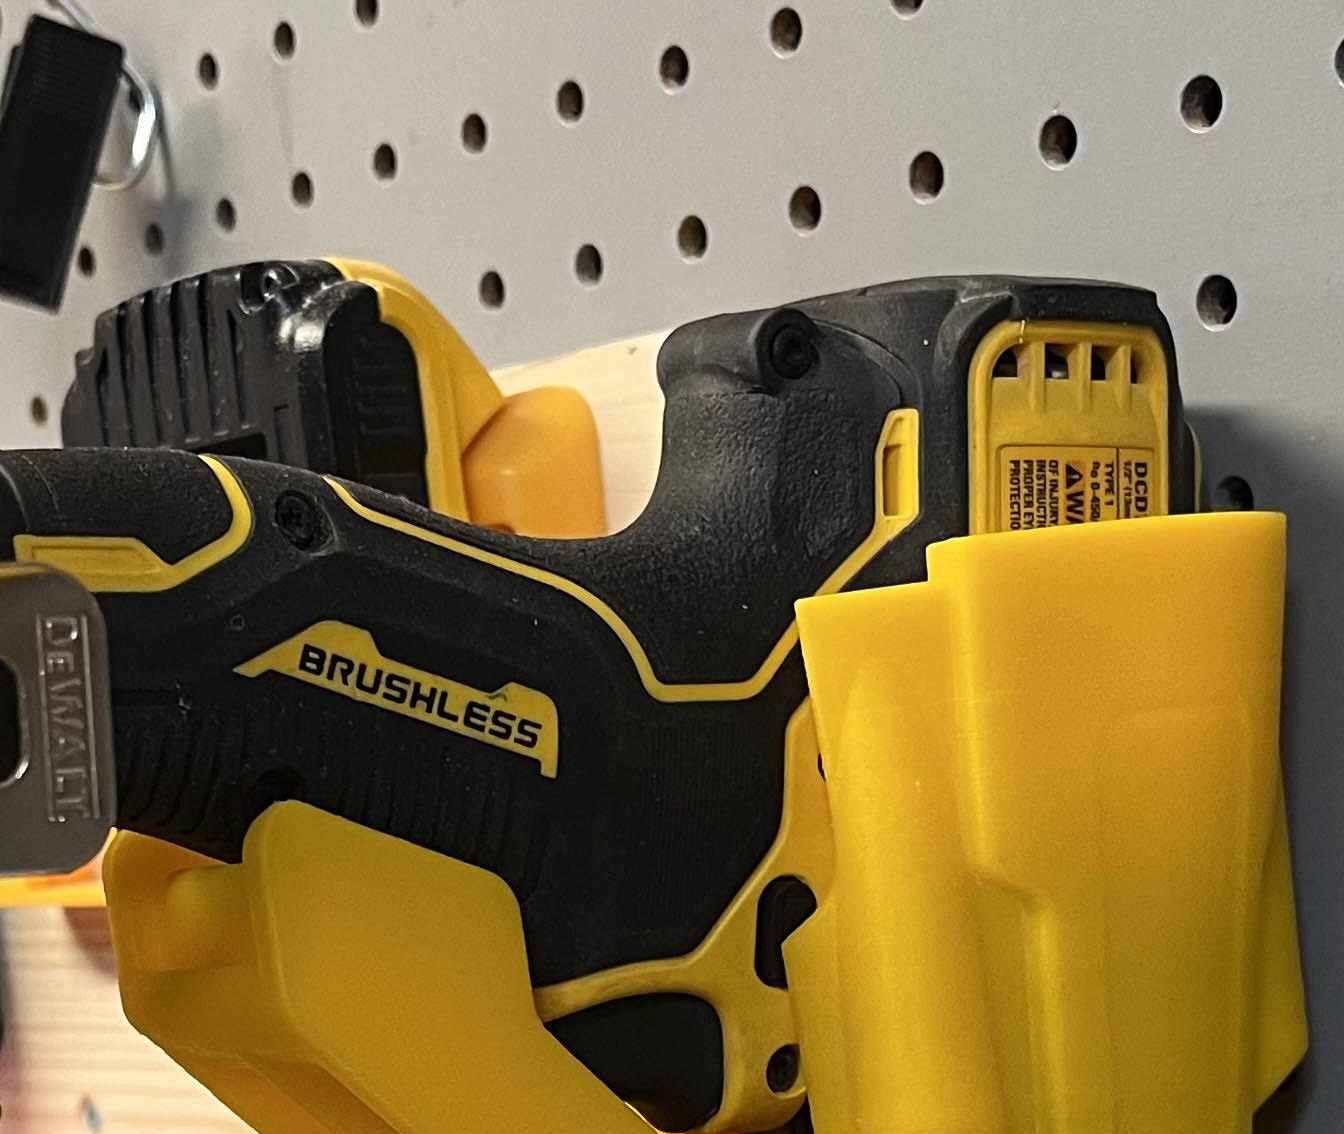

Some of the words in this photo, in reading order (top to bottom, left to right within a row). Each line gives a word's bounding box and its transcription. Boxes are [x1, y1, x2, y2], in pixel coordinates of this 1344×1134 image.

[1023, 459, 1034, 508] PROPER
[1049, 459, 1059, 475] OF
[1104, 461, 1115, 496] TYPE
[1104, 498, 1114, 506] 1
[1134, 462, 1148, 518] DCD
[1023, 511, 1034, 530] EY
[45, 616, 90, 818] DEWALT
[299, 644, 543, 749] BRUSHLESS
